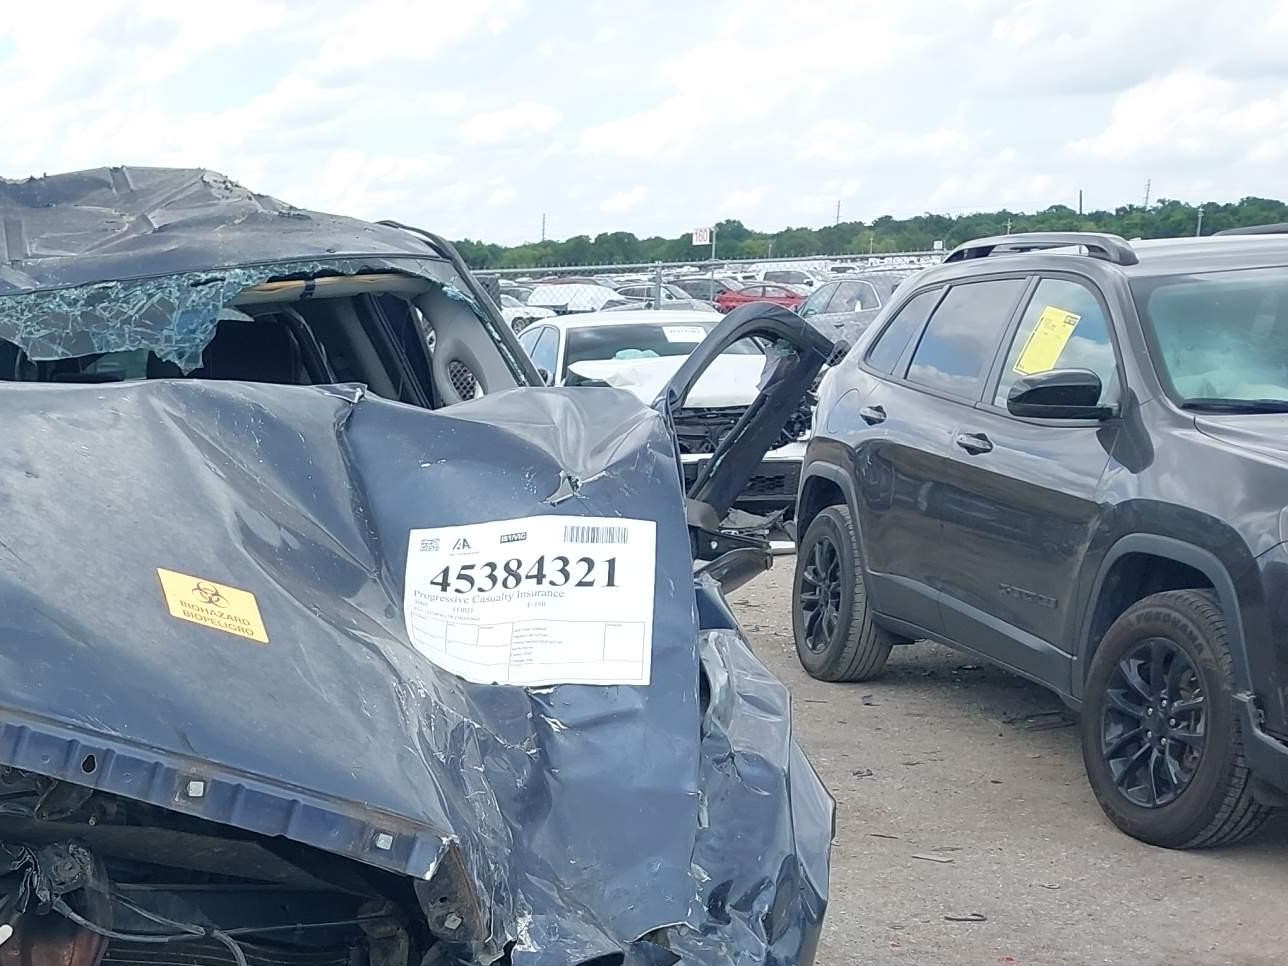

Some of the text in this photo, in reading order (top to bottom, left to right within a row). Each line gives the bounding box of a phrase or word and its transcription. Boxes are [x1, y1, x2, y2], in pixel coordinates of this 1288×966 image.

[430, 555, 620, 594] 45384321
[414, 589, 470, 605] Progressive
[472, 590, 514, 604] Casualty
[516, 589, 565, 599] Insurance
[179, 599, 252, 626] BIOHAZARD
[182, 609, 255, 636] BIOPELIGRO
